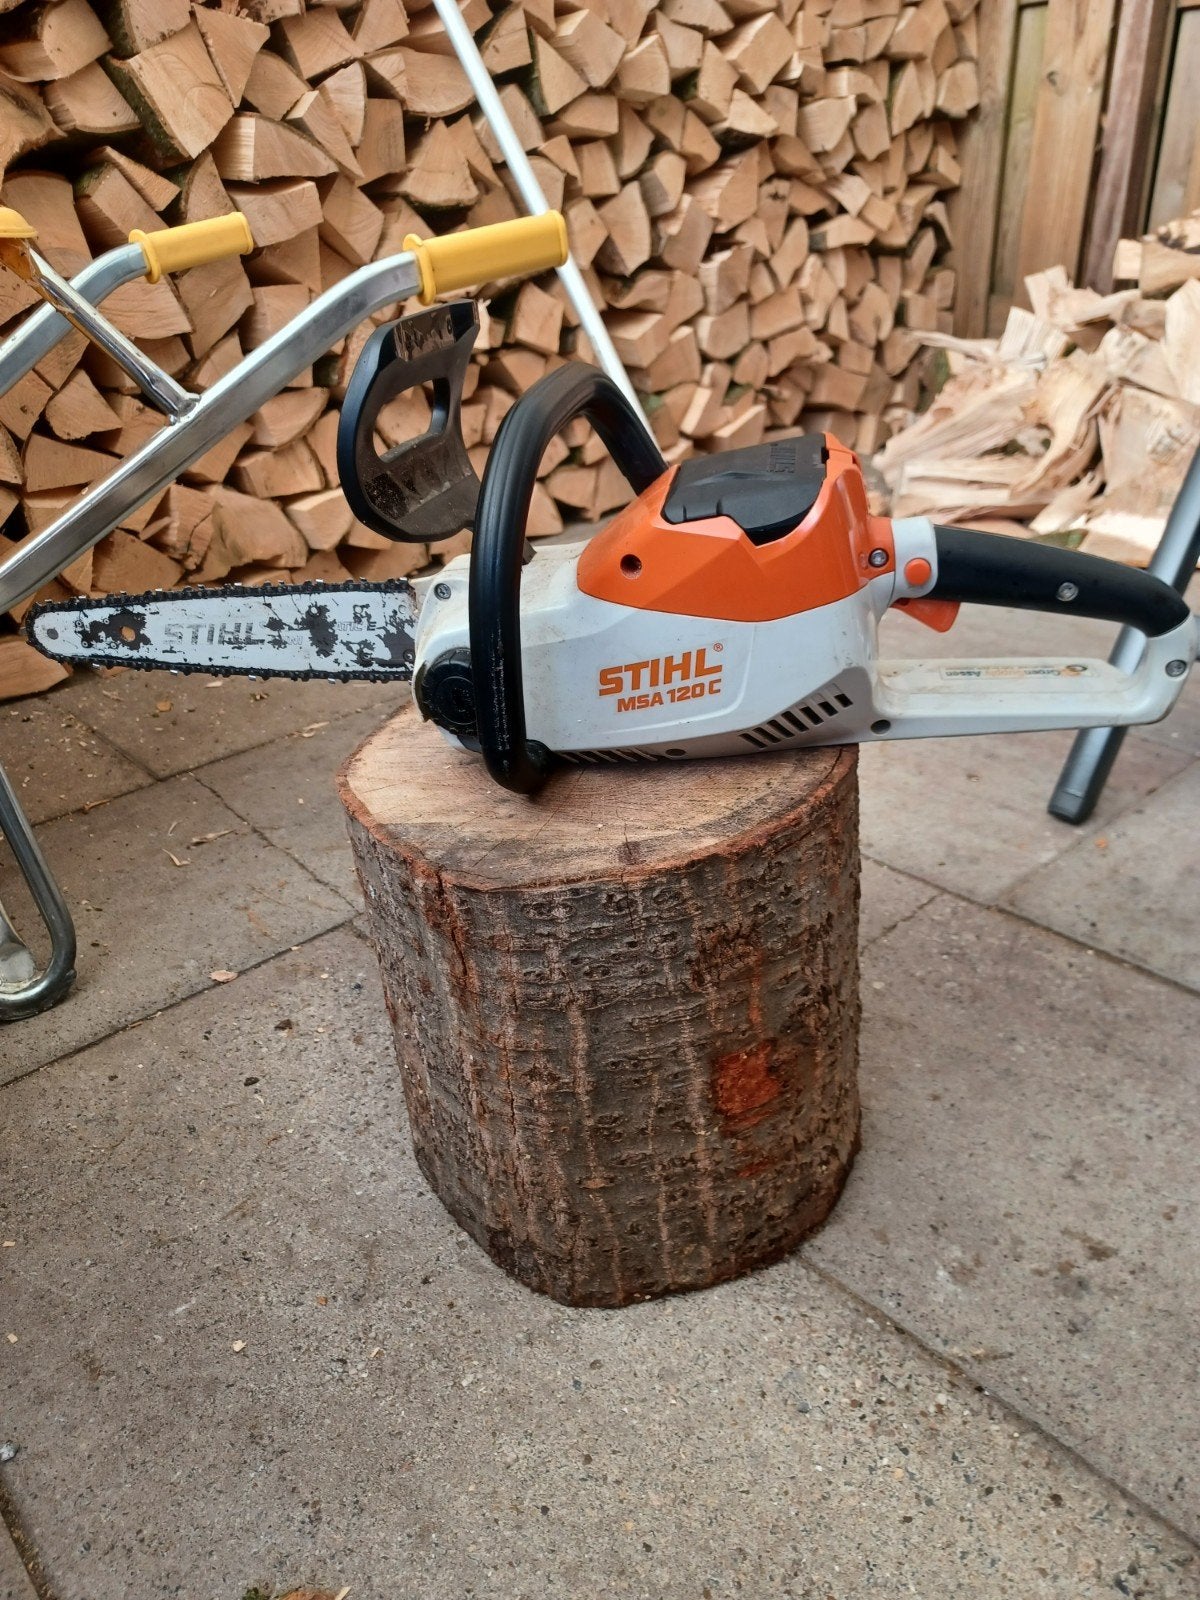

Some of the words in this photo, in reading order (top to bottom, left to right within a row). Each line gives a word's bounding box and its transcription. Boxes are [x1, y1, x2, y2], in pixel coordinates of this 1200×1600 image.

[164, 622, 266, 646] STIHL
[599, 648, 723, 697] STIHL
[617, 691, 664, 713] MSA
[666, 683, 705, 704] 120
[708, 678, 722, 695] C
